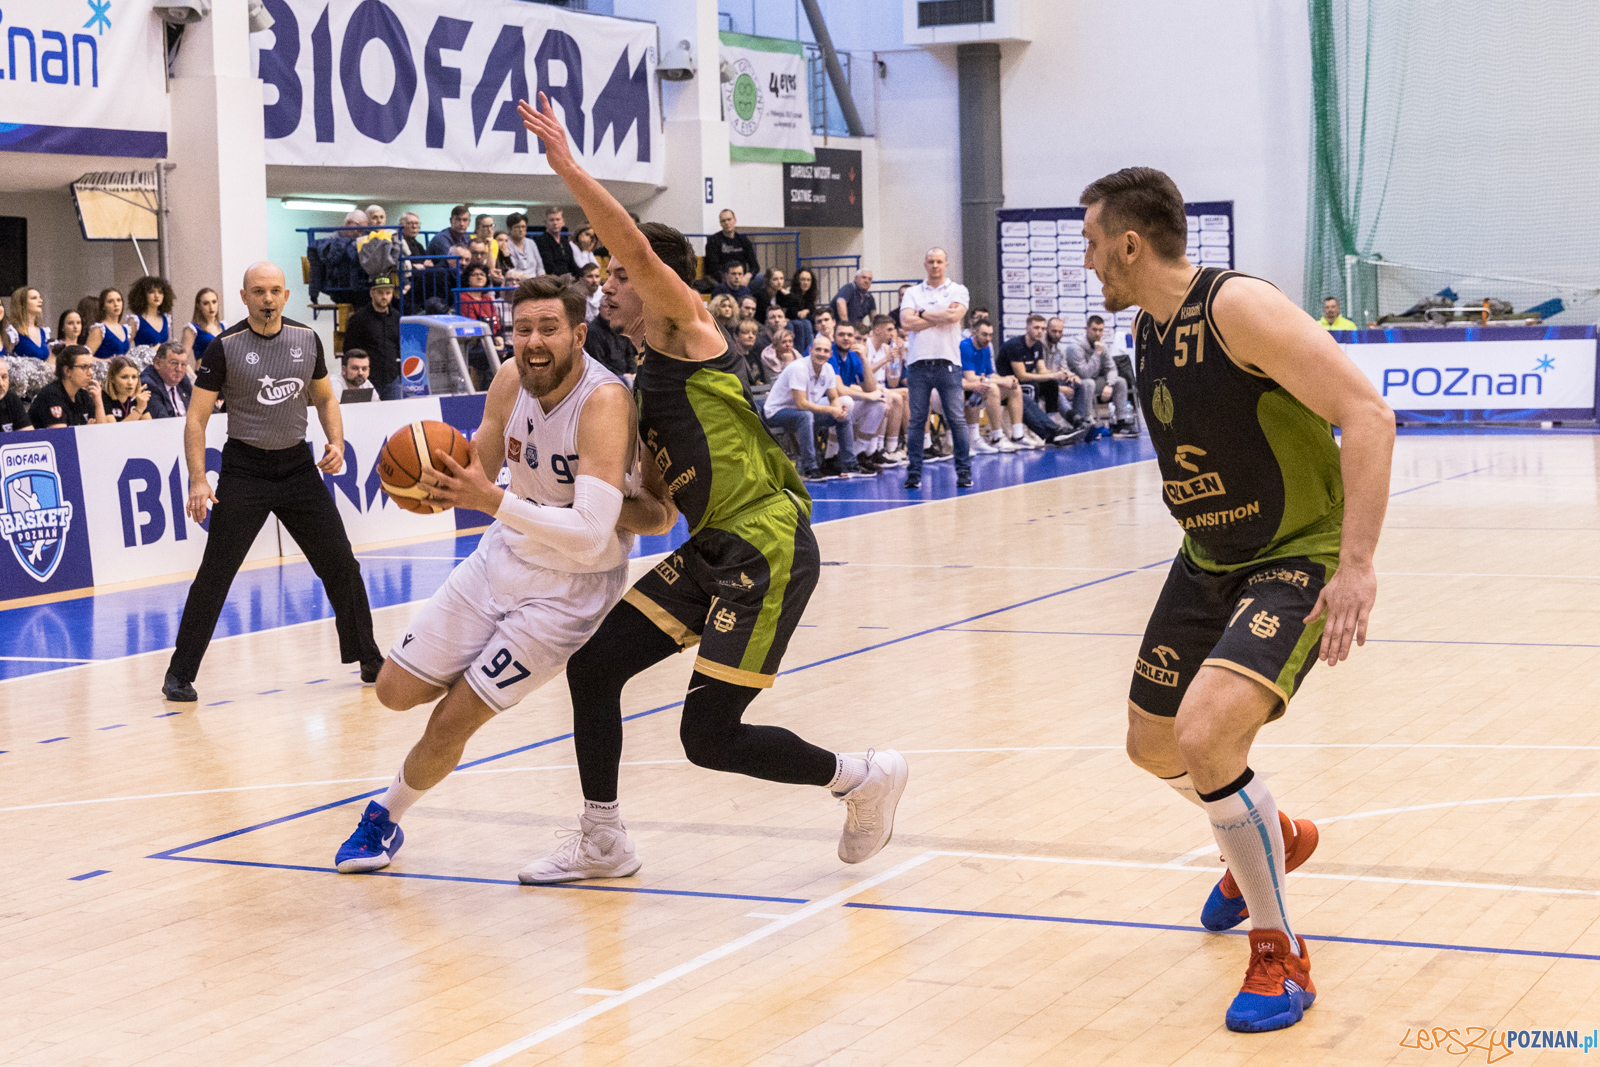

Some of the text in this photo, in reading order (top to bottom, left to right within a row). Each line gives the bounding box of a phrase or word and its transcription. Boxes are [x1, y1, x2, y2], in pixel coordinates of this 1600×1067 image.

[0, 8, 99, 88] nan
[257, 0, 651, 163] BIOFARM
[706, 181, 712, 200] E
[1174, 320, 1205, 367] 57
[266, 382, 296, 400] LOTTO
[1382, 367, 1542, 397] POZnan
[6, 453, 48, 467] BIOFARM
[1, 507, 69, 535] BASKET
[1179, 500, 1260, 533] RANSITION
[17, 528, 58, 542] POZNAŃ
[1229, 597, 1255, 628] 7
[481, 648, 531, 690] 97
[1136, 658, 1175, 684] ORLEN
